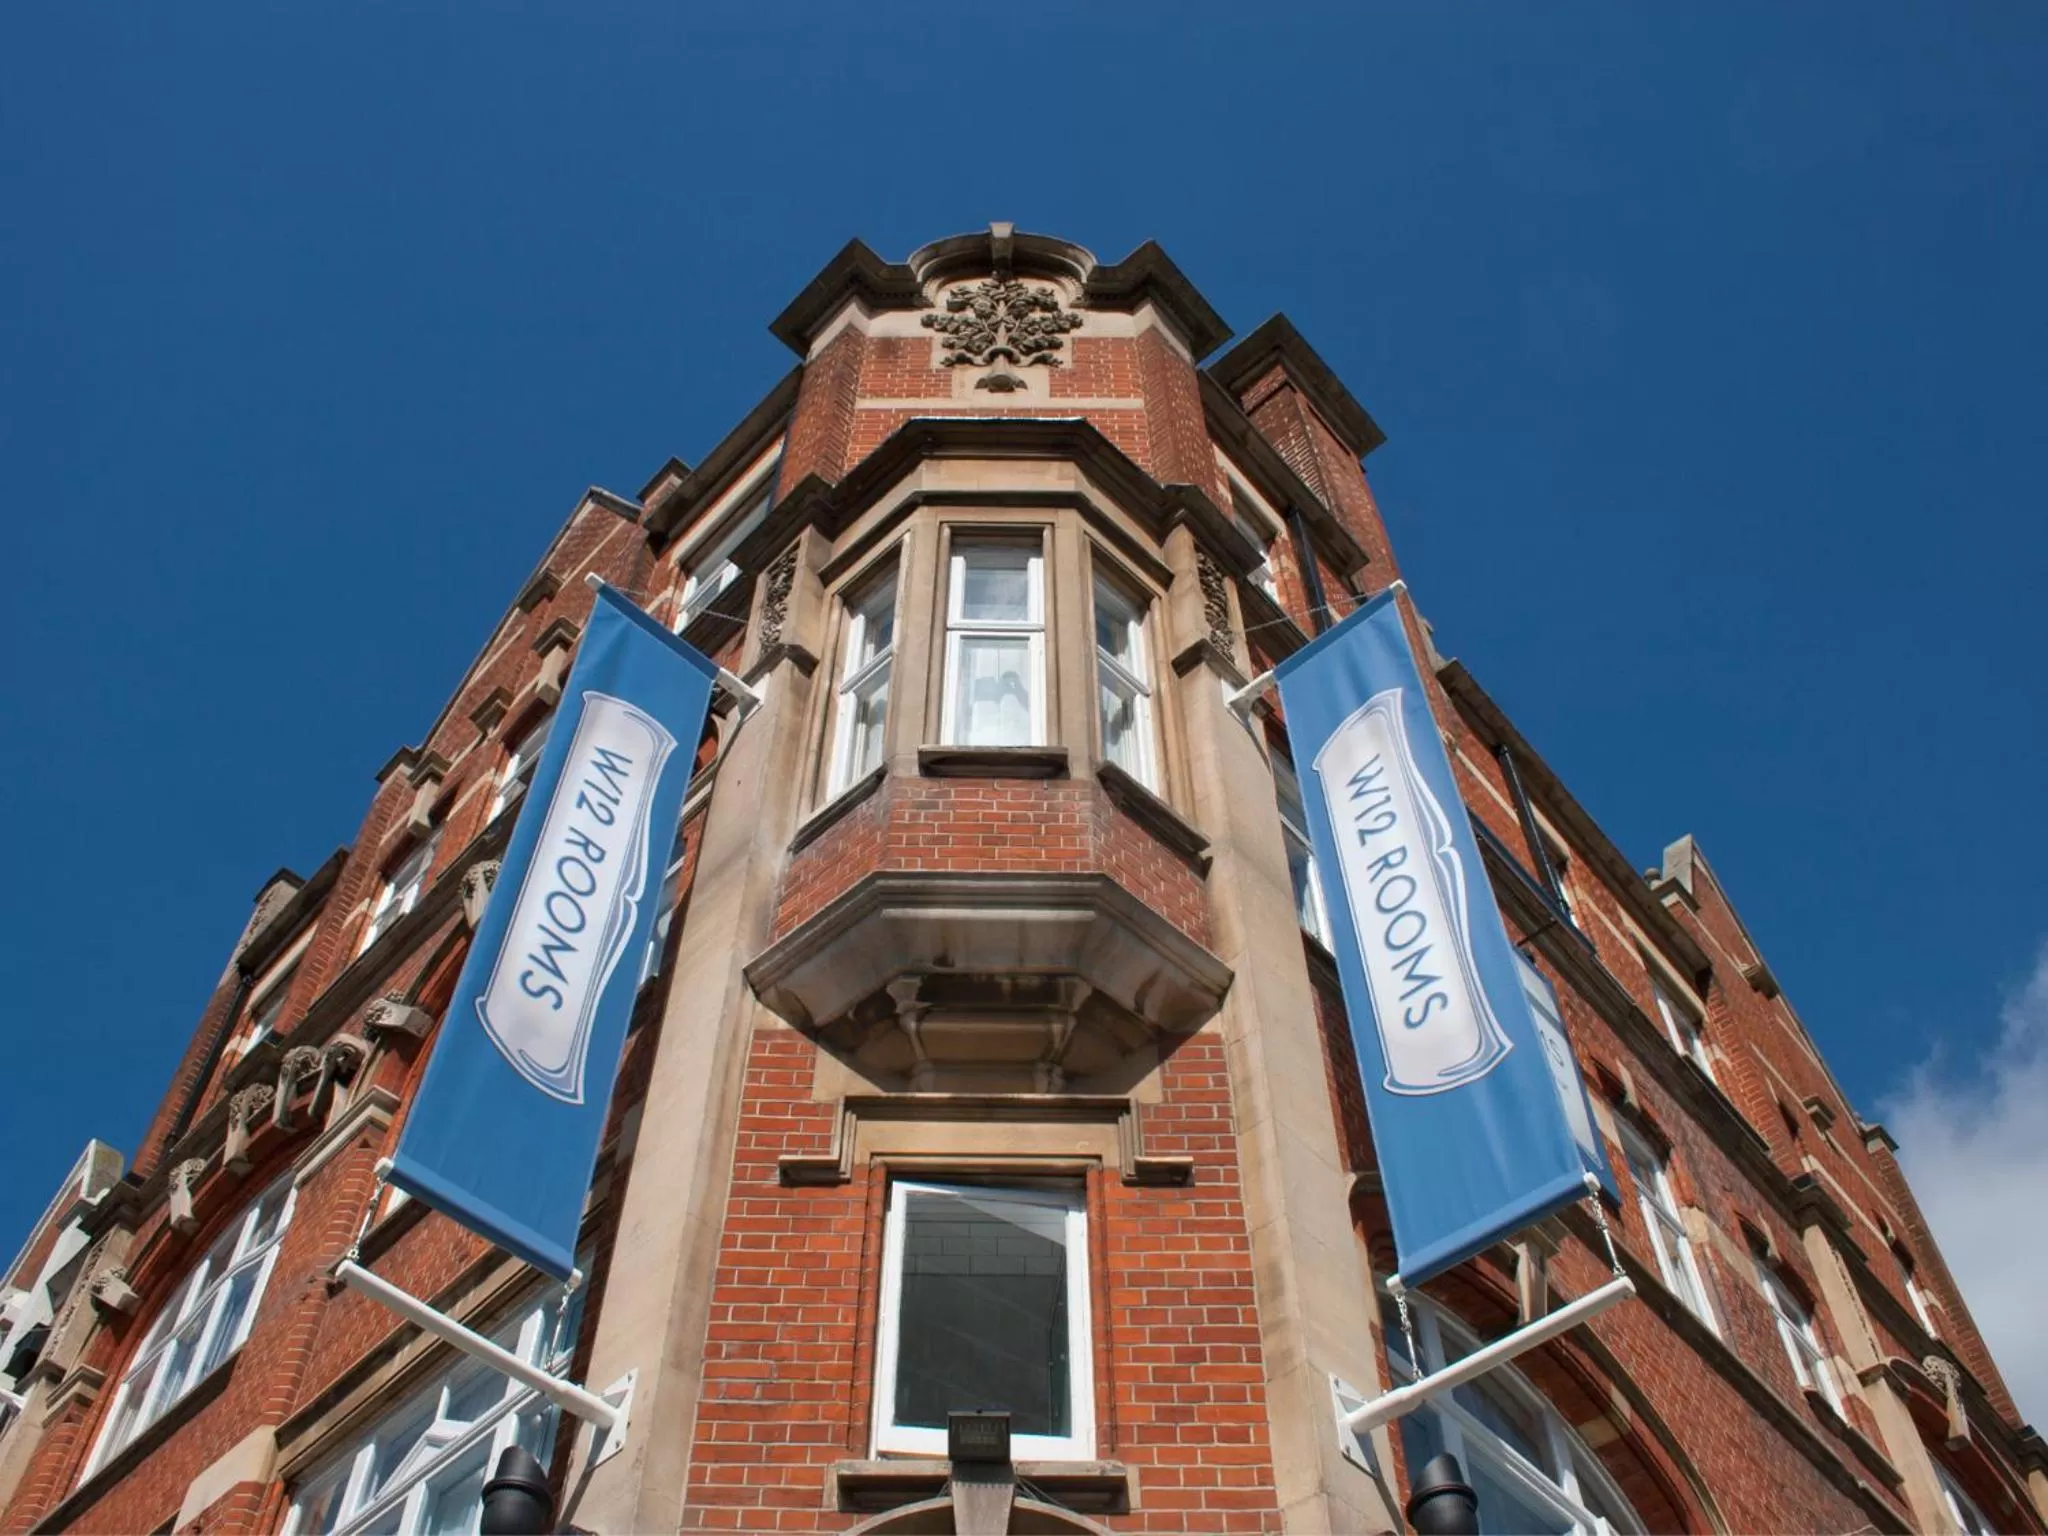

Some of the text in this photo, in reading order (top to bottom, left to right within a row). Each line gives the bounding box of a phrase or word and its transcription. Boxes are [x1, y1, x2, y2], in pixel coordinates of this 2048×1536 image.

[520, 746, 633, 1011] W12 ROOMS
[1347, 754, 1447, 1030] W12 ROOMS
